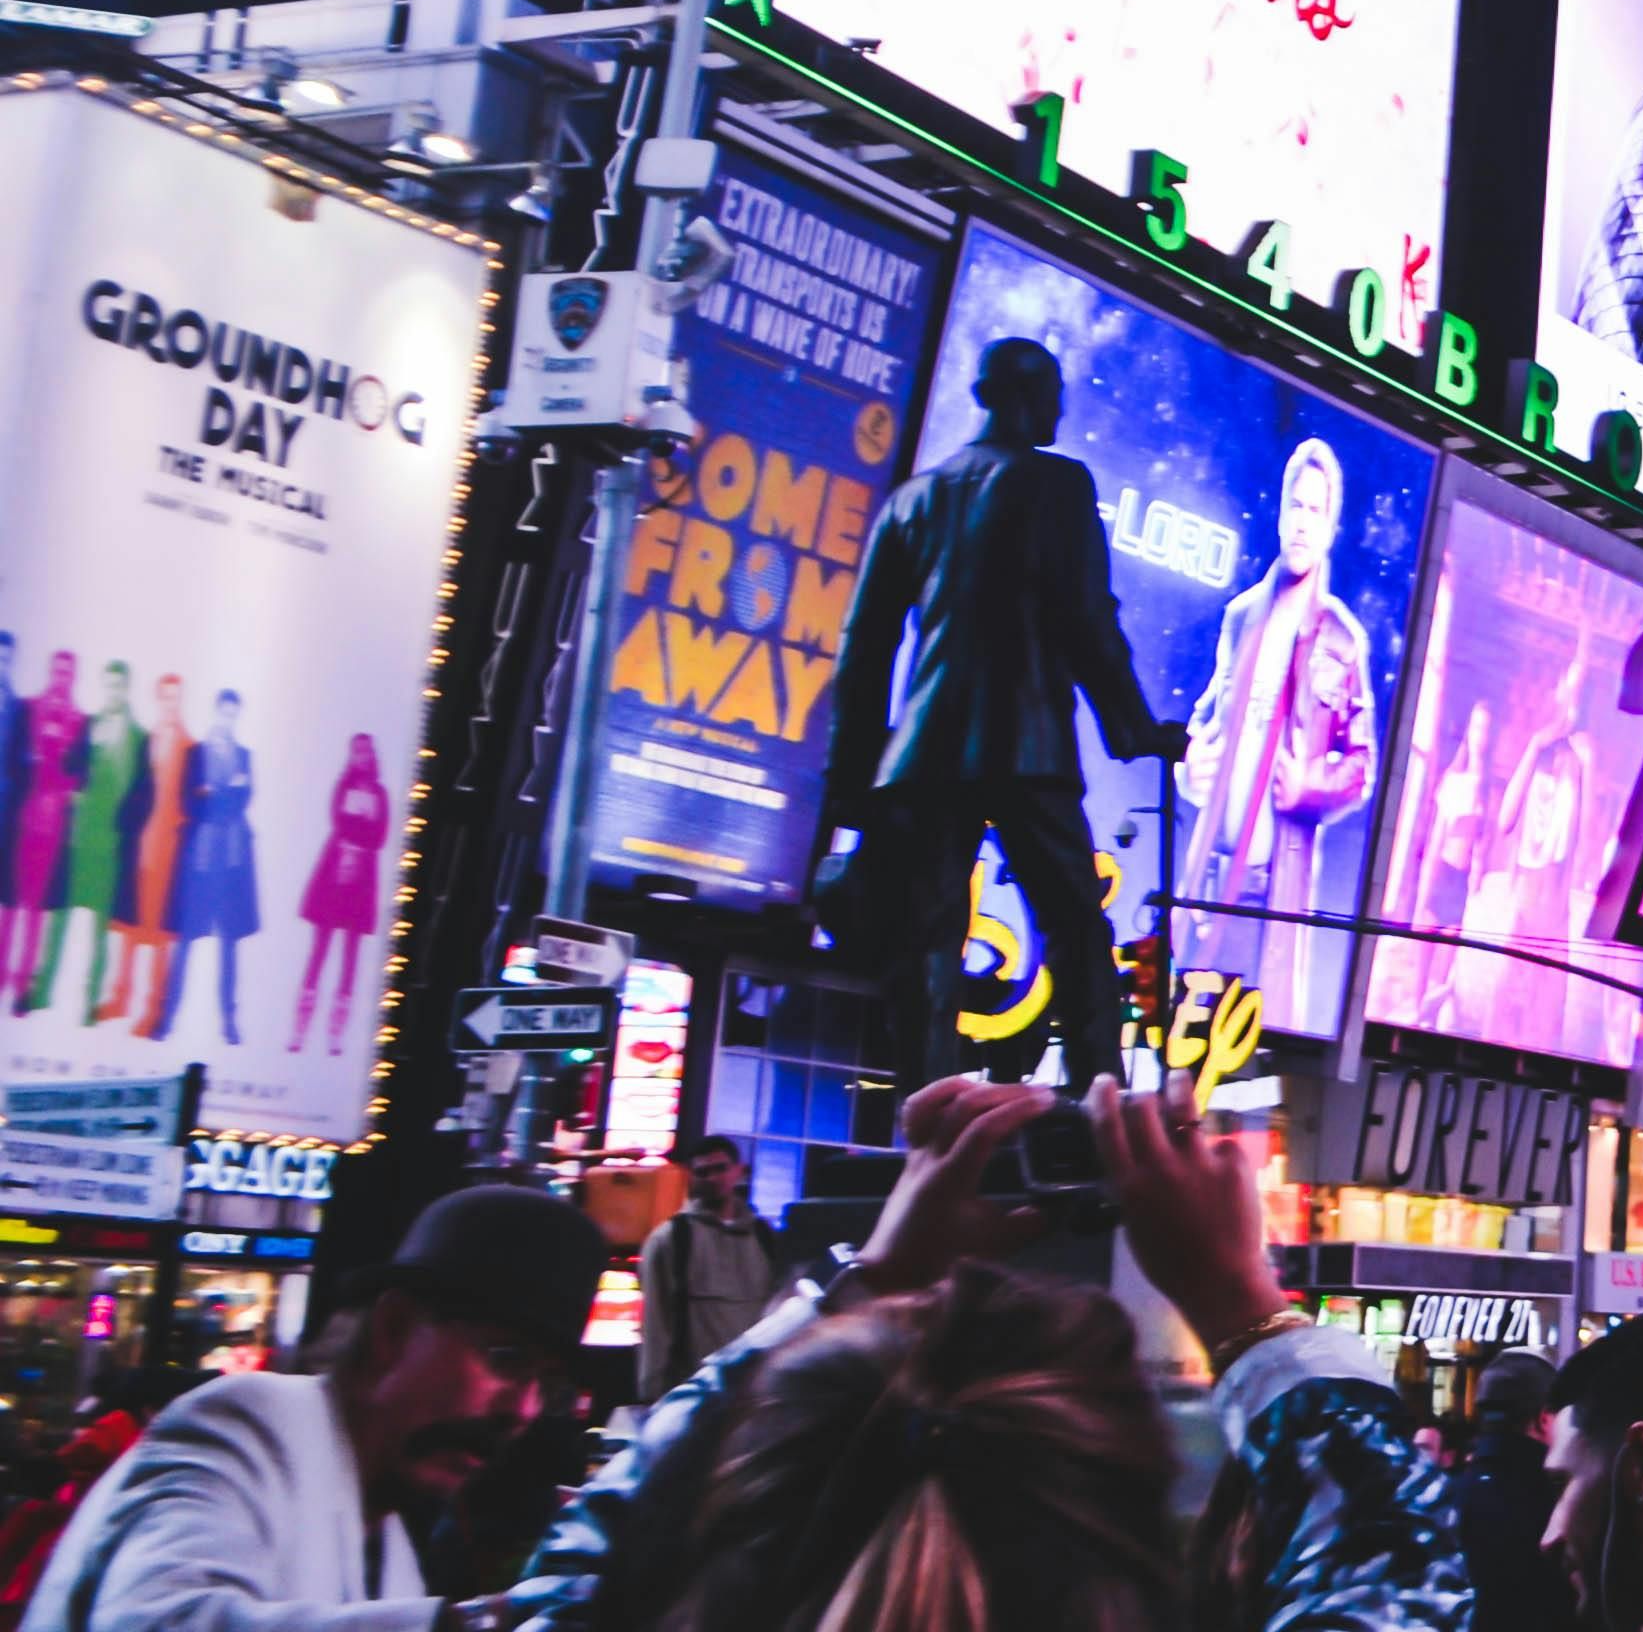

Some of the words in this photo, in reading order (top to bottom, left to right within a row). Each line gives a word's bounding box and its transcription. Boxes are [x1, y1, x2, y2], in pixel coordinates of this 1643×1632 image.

[1012, 92, 1387, 358] 1540
[729, 292, 748, 333] A
[751, 299, 815, 361] WAVE
[813, 327, 844, 370] OF
[731, 241, 859, 331] TRANSPORTS
[858, 299, 888, 344] US
[80, 278, 427, 448] GROUNDHOG
[197, 385, 306, 468] DAY
[158, 444, 206, 483] THE
[216, 464, 328, 520] MUSICAL
[609, 606, 836, 743] AWAY
[503, 1007, 544, 1031] ONE
[552, 1006, 601, 1029] WAY
[1353, 1064, 1583, 1206] FOREVER
[1404, 1294, 1507, 1343] FOREVER
